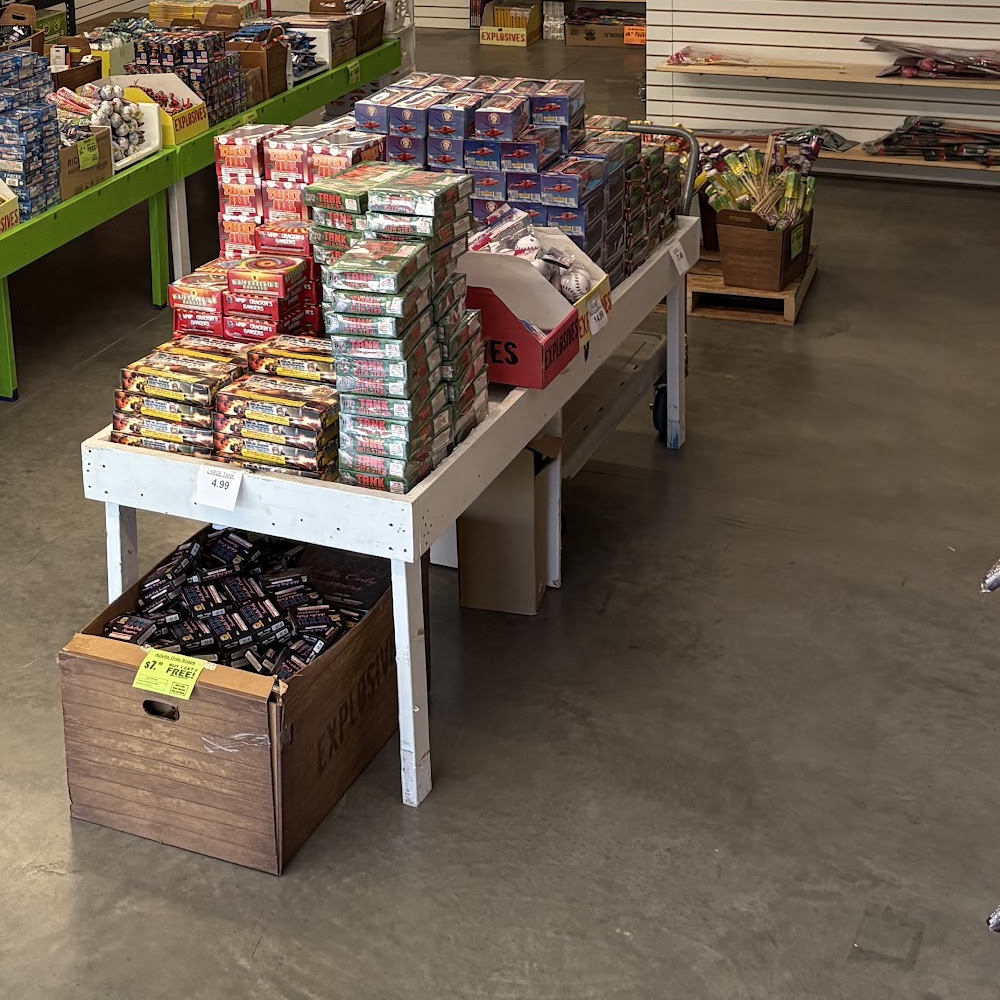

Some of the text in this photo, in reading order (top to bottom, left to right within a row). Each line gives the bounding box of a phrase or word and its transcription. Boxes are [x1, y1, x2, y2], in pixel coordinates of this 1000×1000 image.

[481, 31, 526, 43] EXPLOSIVES
[174, 106, 207, 132] EXPLOSIVES
[317, 192, 342, 205] TANK
[323, 232, 348, 245] TANK
[344, 271, 374, 281] TANK
[350, 339, 380, 350] TANK
[544, 316, 579, 370] EXPLOSIVES
[353, 359, 384, 370] TANK
[358, 399, 389, 410] TANK
[357, 417, 387, 428] TANK
[357, 436, 385, 448] TANK
[356, 455, 385, 468] TANK
[207, 468, 235, 480] LARGE TANK
[211, 479, 230, 490] 4.99
[356, 474, 385, 487] TANK
[155, 652, 170, 660] Adults
[182, 658, 196, 666] Snaps
[166, 667, 197, 680] FREE!
